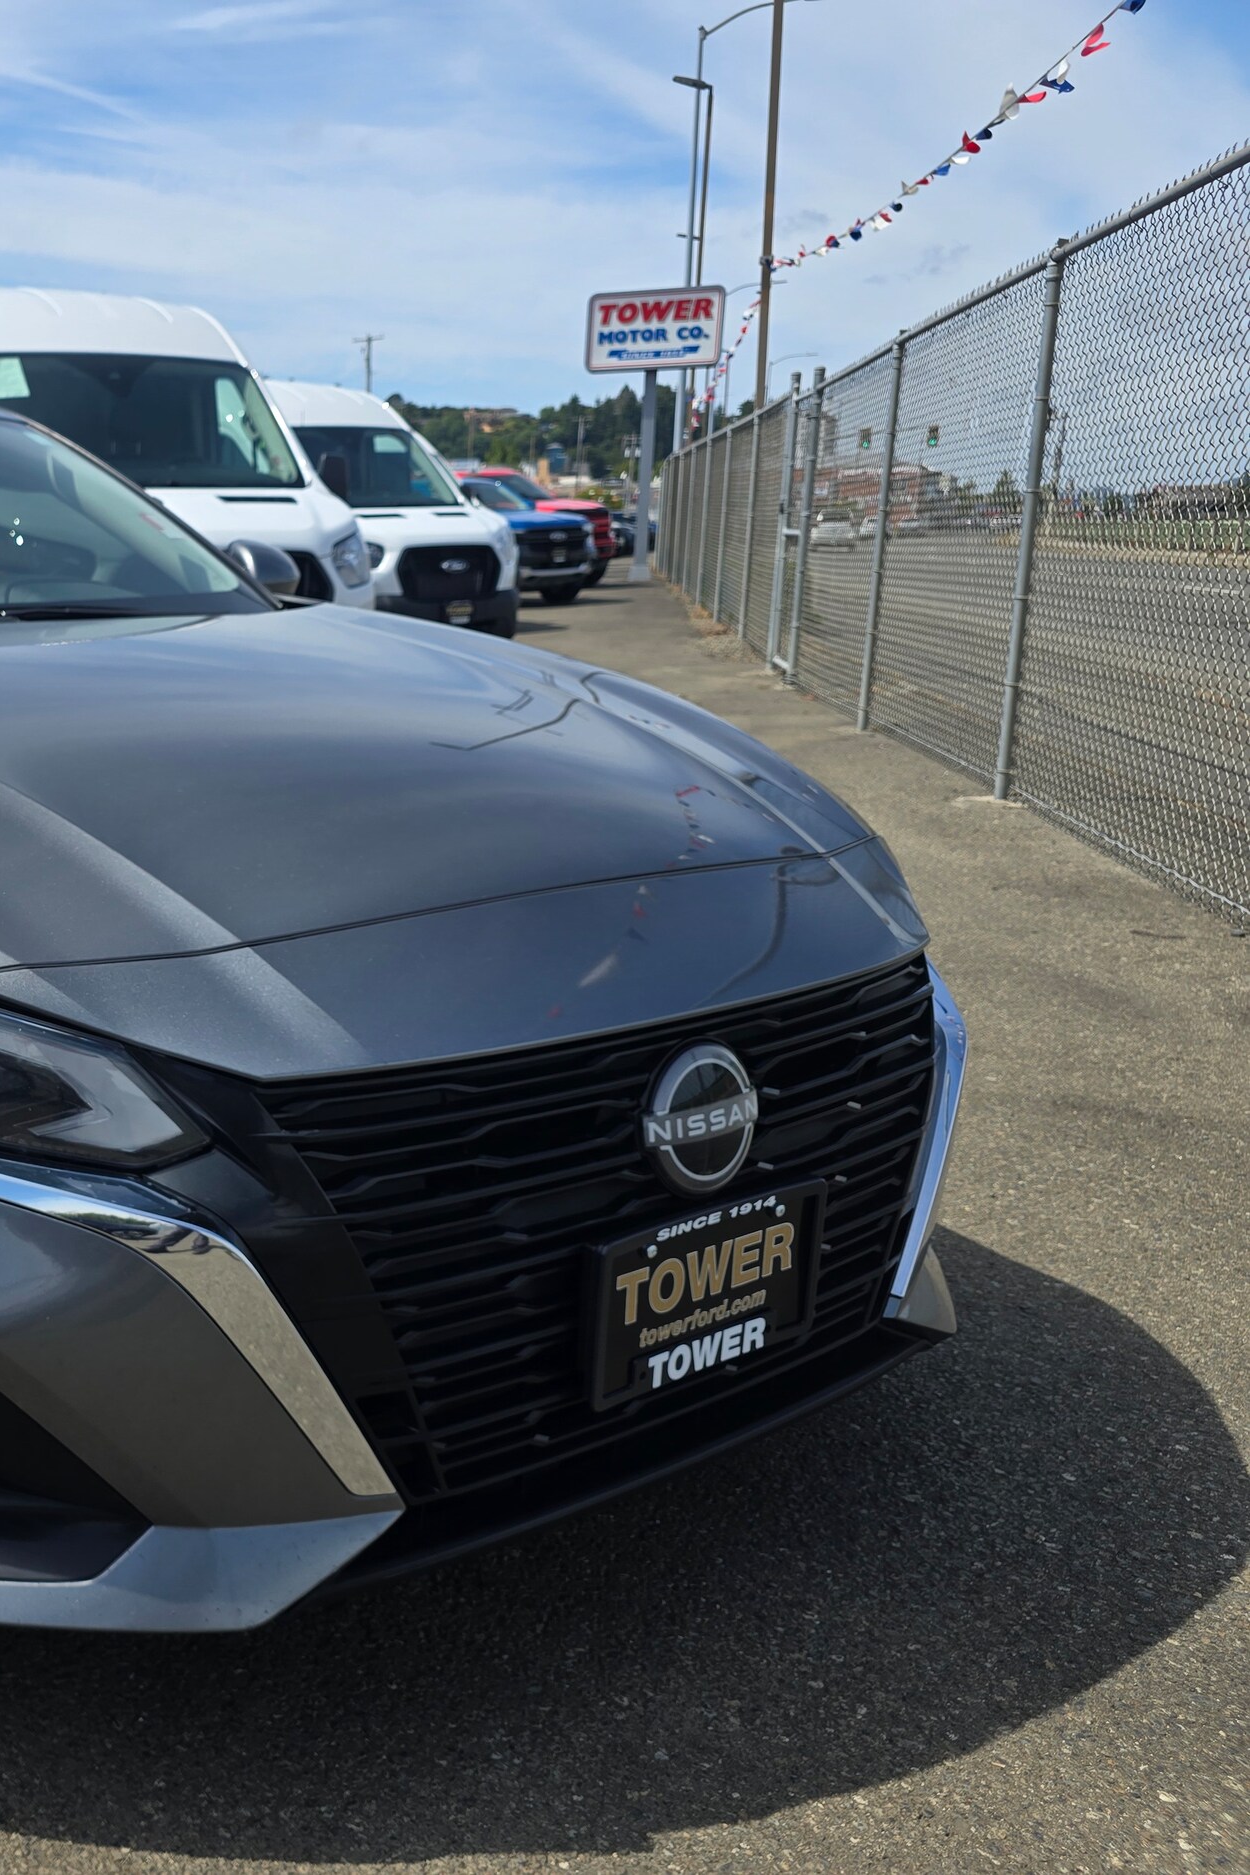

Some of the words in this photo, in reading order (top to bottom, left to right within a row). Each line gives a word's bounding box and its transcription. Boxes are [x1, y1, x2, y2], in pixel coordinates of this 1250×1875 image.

[597, 328, 668, 345] MOTOR
[676, 326, 710, 340] CO.
[599, 298, 714, 326] TOWER
[648, 1099, 757, 1143] NISSAN
[656, 1213, 721, 1242] SINCE
[728, 1195, 777, 1219] 1914
[616, 1222, 794, 1325] TOWER
[639, 1288, 766, 1348] towerford.com
[648, 1317, 766, 1389] TOWER
